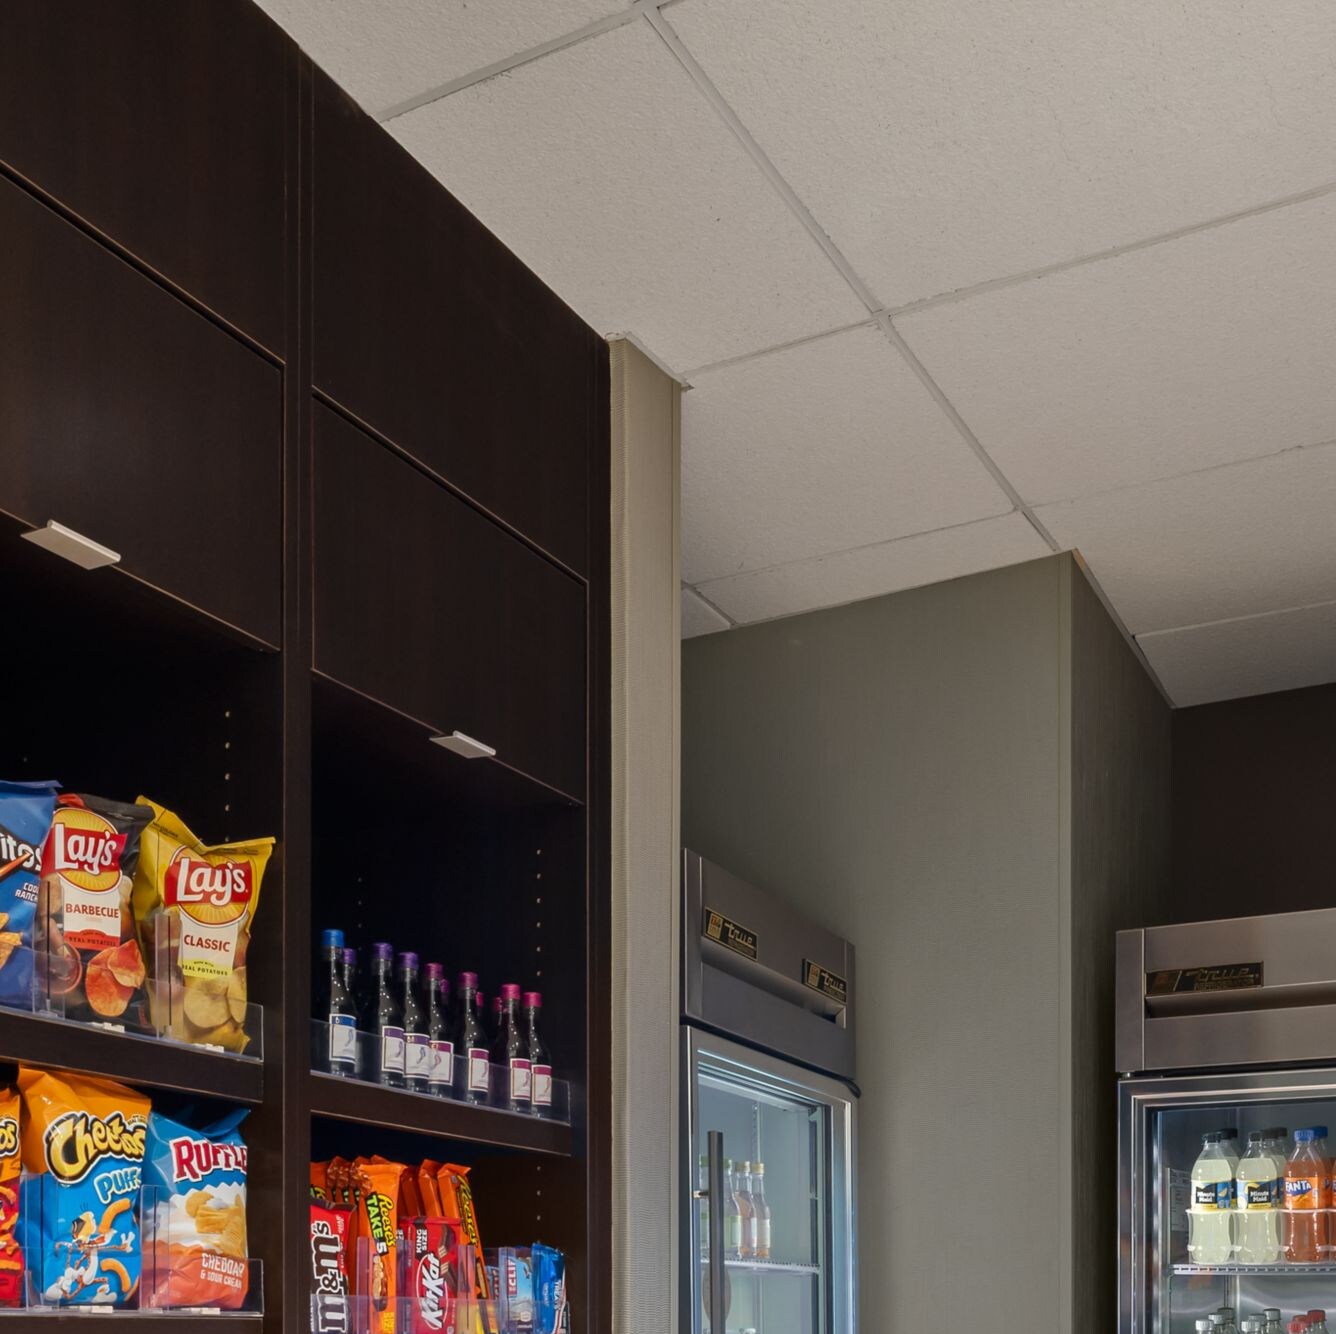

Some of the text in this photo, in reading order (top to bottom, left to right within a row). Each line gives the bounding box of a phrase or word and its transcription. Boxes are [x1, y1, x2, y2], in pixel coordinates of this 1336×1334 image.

[54, 824, 117, 876] Lay's
[176, 857, 247, 906] Lay's
[65, 903, 119, 918] BARBECUE
[184, 935, 231, 952] CLASSIC
[47, 1112, 146, 1182] Cheetos
[366, 1194, 388, 1254] TAKE 5
